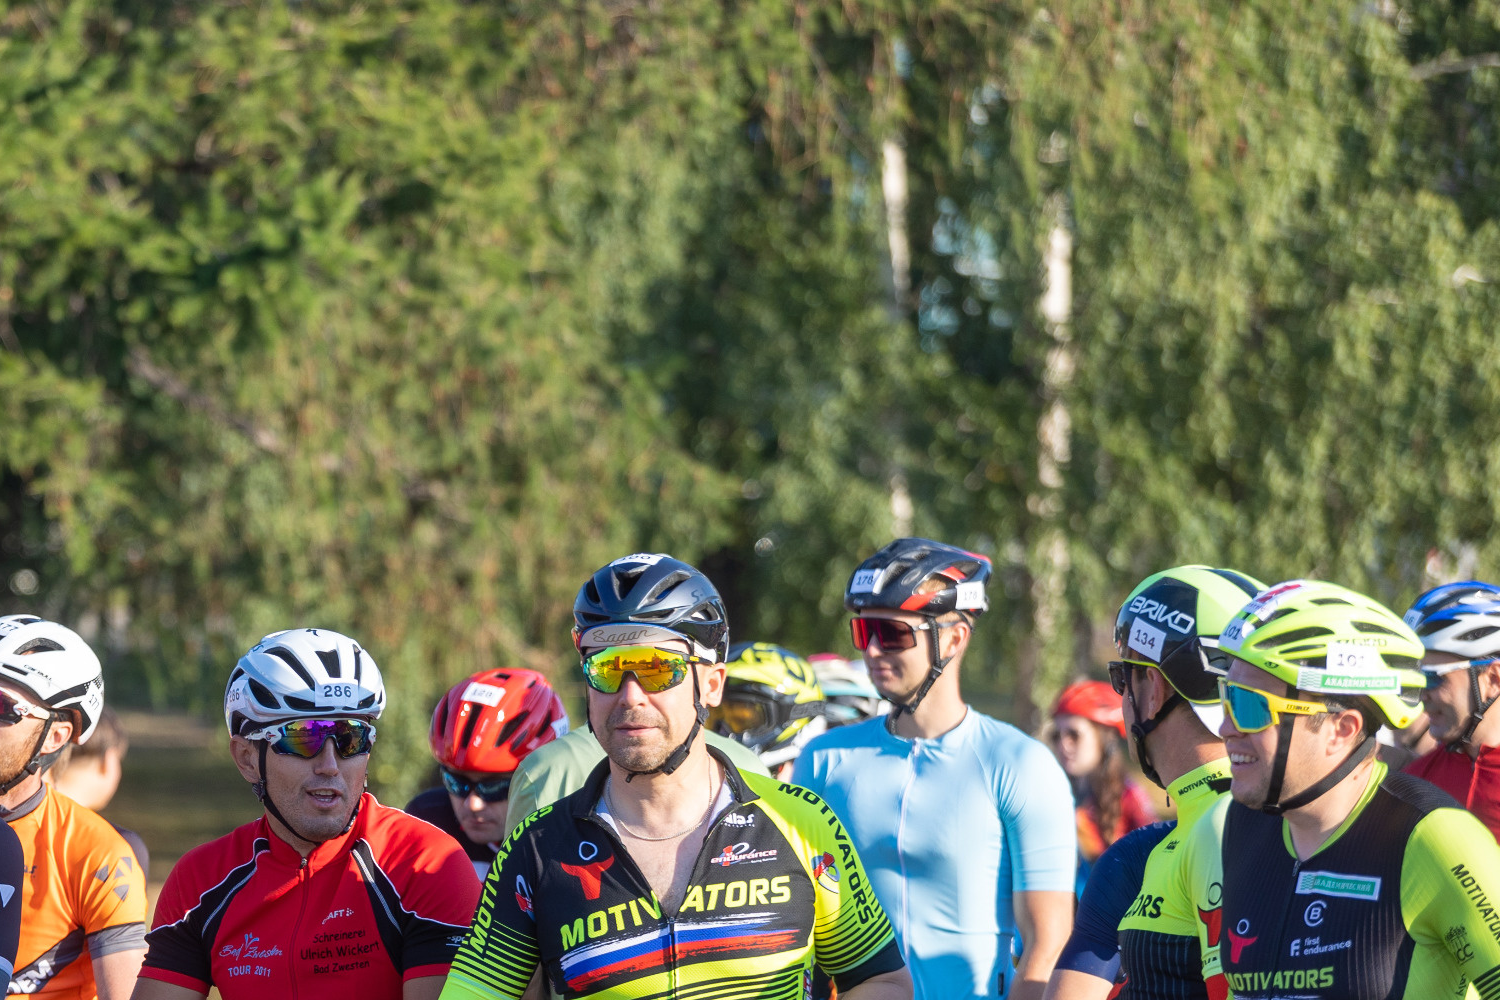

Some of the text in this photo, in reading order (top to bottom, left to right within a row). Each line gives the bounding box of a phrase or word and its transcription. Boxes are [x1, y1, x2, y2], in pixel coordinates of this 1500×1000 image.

[856, 575, 874, 586] 178
[1129, 595, 1195, 635] BRIKO
[592, 629, 657, 645] Sagan
[1134, 629, 1156, 649] 134
[1224, 625, 1241, 641] 101
[323, 685, 352, 698] 286
[1178, 771, 1224, 796] MOTIVATORS
[711, 848, 778, 864] endurance
[778, 783, 874, 925] MOTIVATORS
[468, 804, 553, 958] MOTIVATORS
[1303, 940, 1353, 956] endurance
[1304, 936, 1320, 946] first
[300, 941, 381, 961] Ulrich Wickert
[228, 965, 272, 978] TOUR 2011
[313, 960, 371, 975] Bad Zwesten
